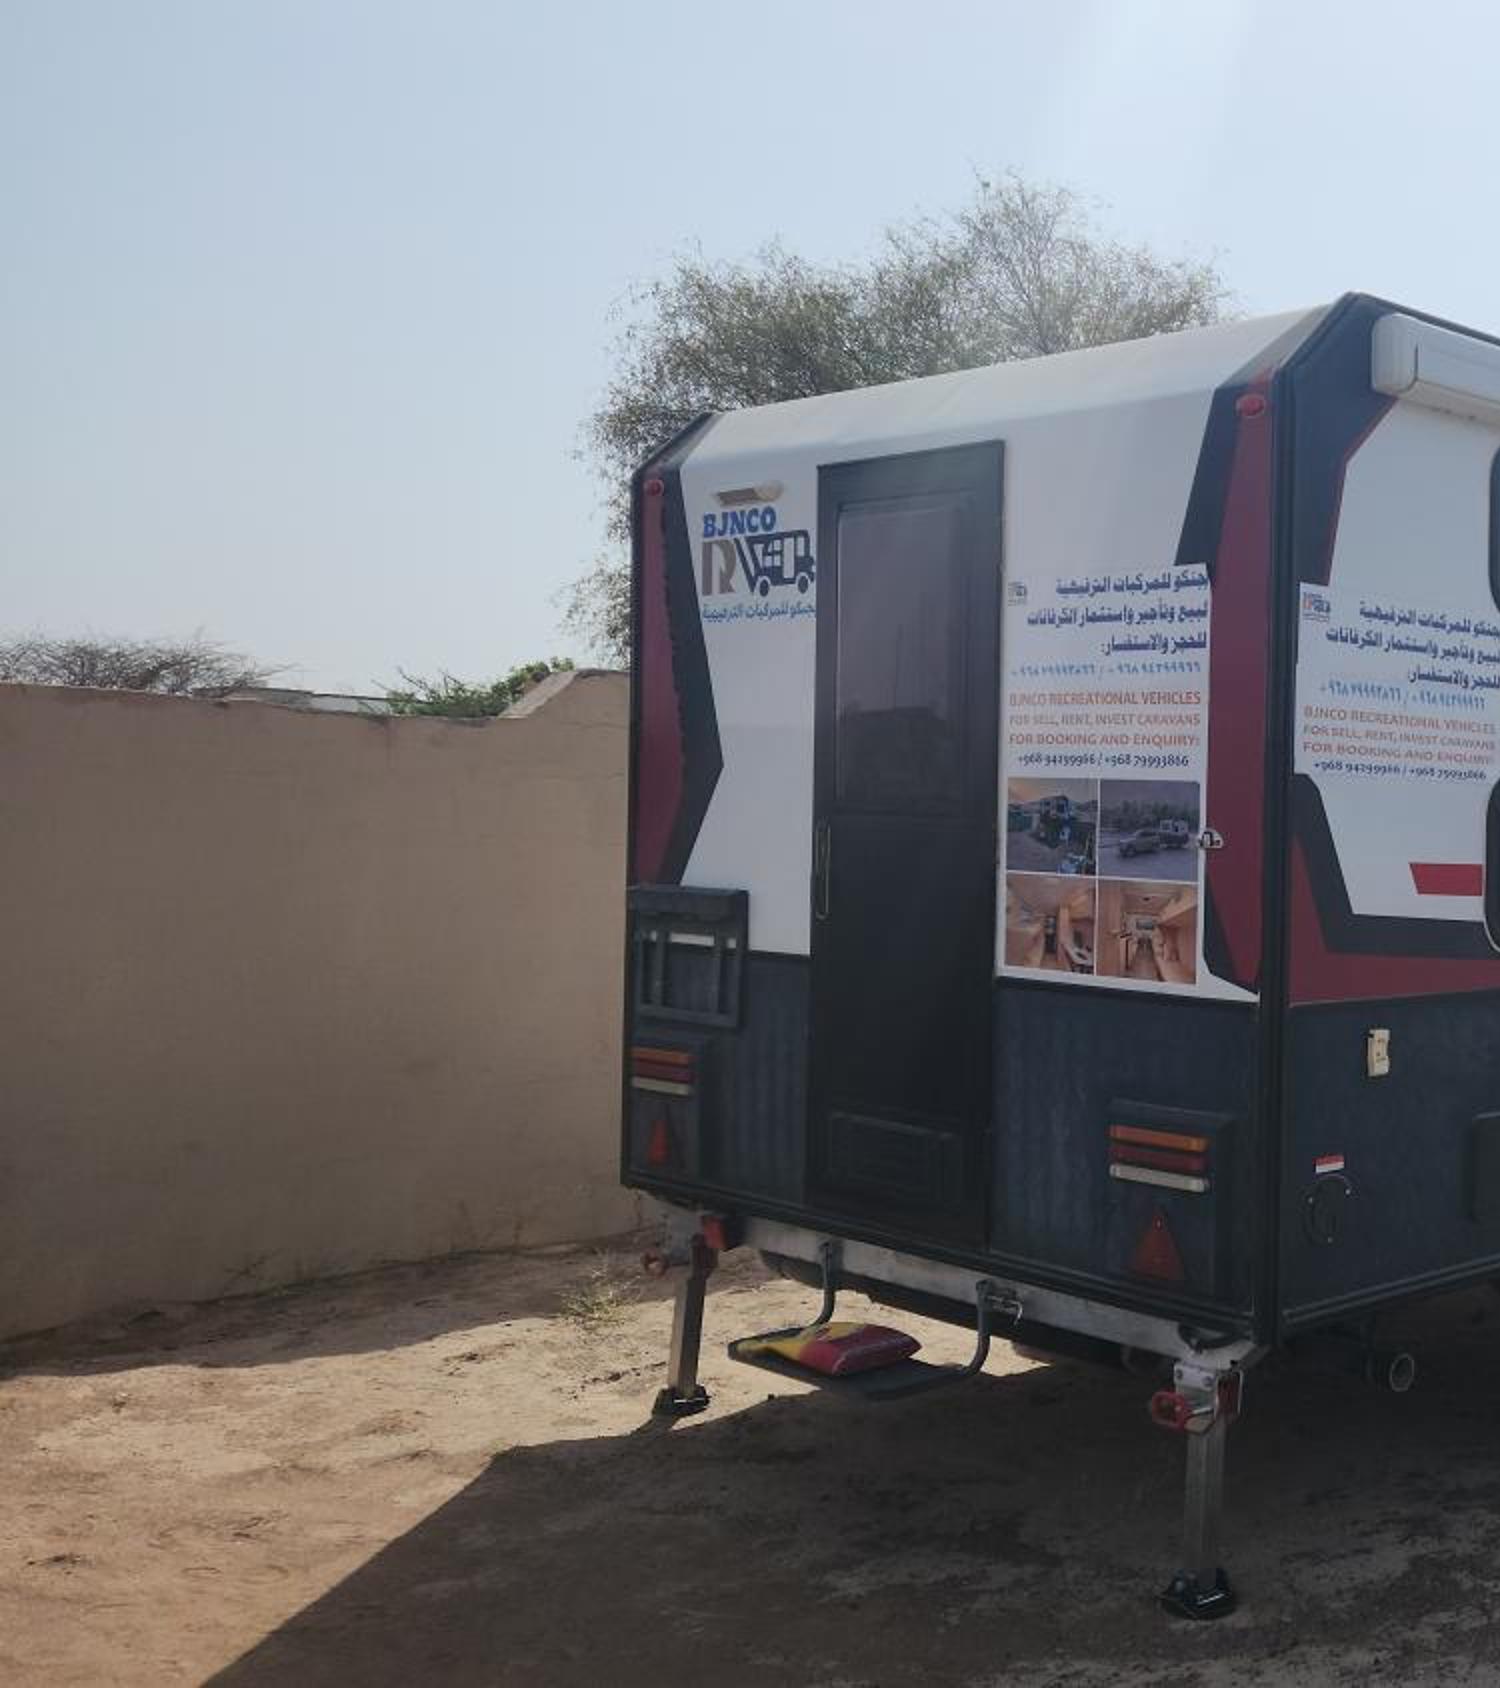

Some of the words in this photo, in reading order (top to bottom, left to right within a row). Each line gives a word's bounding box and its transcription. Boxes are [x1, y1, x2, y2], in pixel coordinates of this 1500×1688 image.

[703, 506, 777, 538] BJNCO
[1056, 576, 1111, 599] الترفيهية
[1113, 572, 1171, 596] للمركبات
[1027, 608, 1077, 628] الكرفانات
[1079, 603, 1134, 628] واستثمار
[1136, 597, 1175, 624] وتأجير
[1178, 600, 1207, 623] لبيع
[1360, 601, 1416, 627] الترفيهية
[1418, 612, 1471, 635] للمركبات
[1171, 631, 1207, 654] للحجز
[1326, 626, 1382, 650] الكرفانات
[1384, 633, 1438, 659] واستثمار
[1440, 639, 1475, 664] وتأجير
[1477, 648, 1500, 667] لبيع
[1471, 674, 1500, 692] للحجز
[1048, 691, 1138, 705] RECREATIONAL
[1141, 691, 1201, 705] VEHICLES
[1009, 714, 1030, 726] FOR
[1095, 713, 1136, 726] INVEST
[1137, 713, 1201, 726] CARAVANS
[1304, 704, 1347, 720] BJNCO
[1351, 709, 1441, 730] RECREATIONAL
[1443, 719, 1496, 735] VEHICLES
[1009, 733, 1033, 745] FOR
[1037, 733, 1097, 745] BOOKING
[1099, 733, 1129, 746] AND
[1303, 723, 1329, 736] FOR
[1399, 732, 1438, 745] INVEST
[1440, 736, 1495, 751] CARAVANS
[1303, 742, 1332, 754] FOR
[1337, 743, 1401, 759] BOOKING
[1405, 749, 1433, 761] AND
